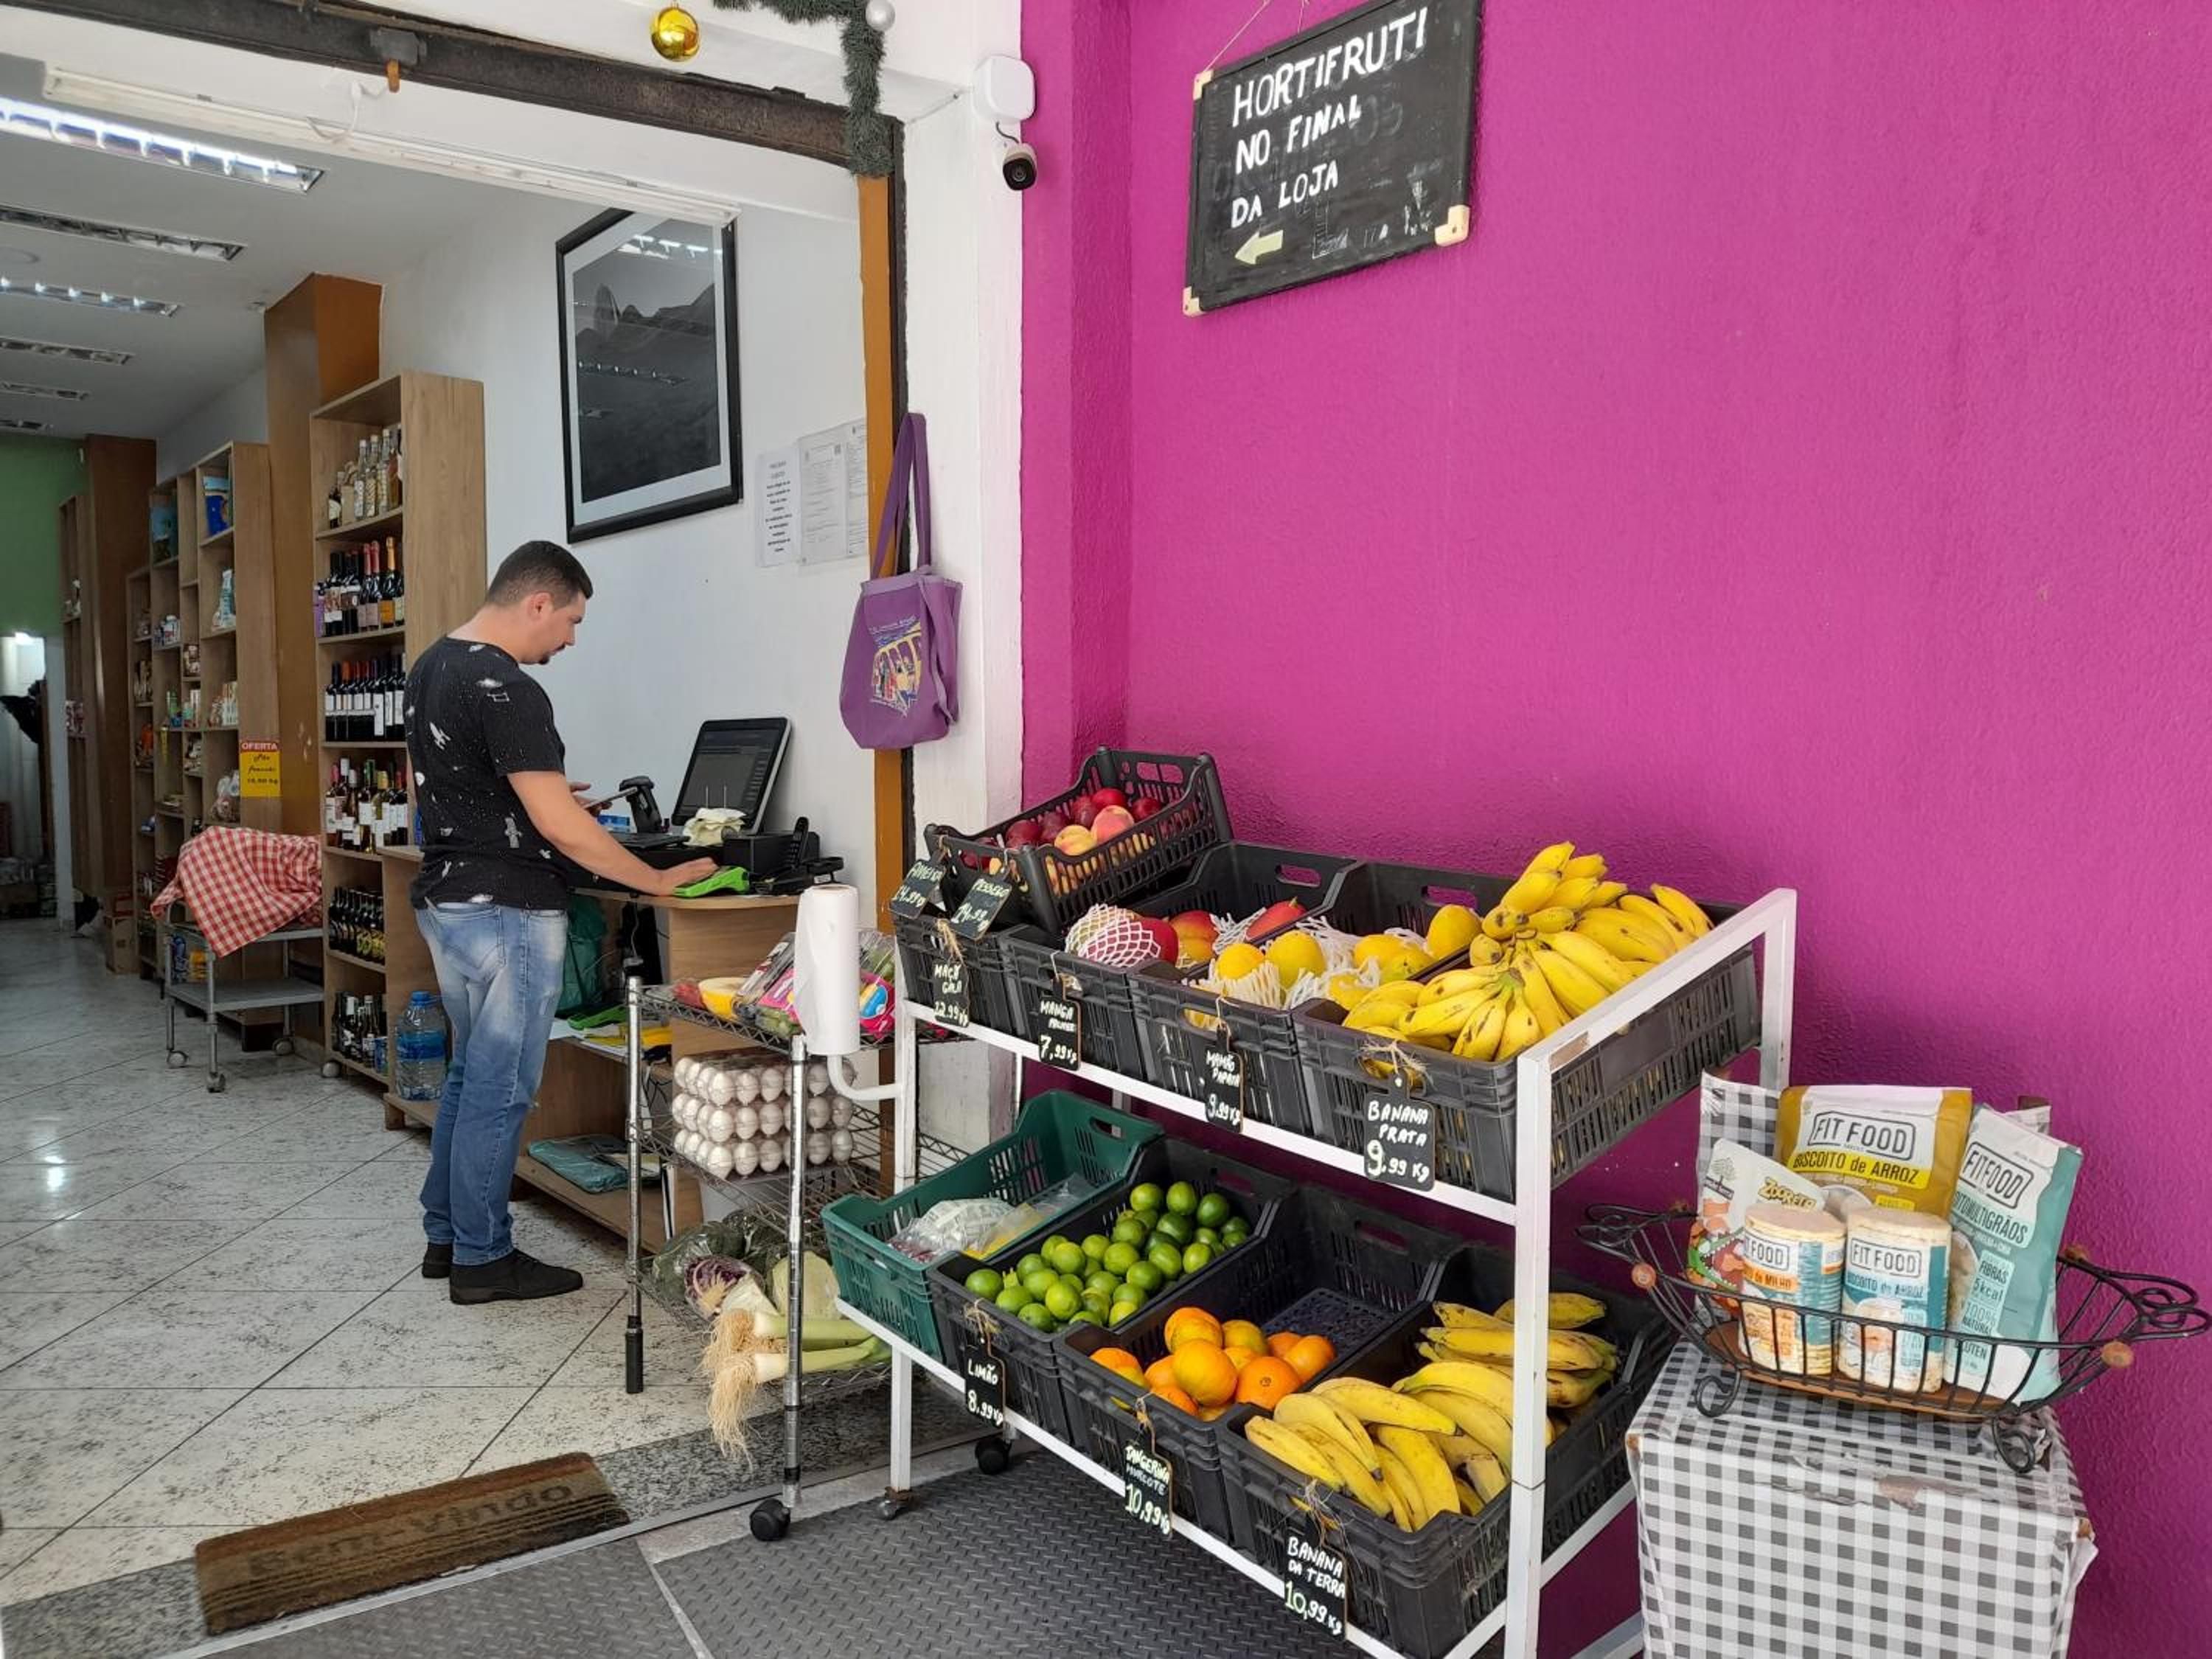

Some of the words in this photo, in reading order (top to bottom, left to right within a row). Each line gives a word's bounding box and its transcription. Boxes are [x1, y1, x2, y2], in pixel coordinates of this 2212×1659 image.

[1232, 7, 1428, 128] HORTIFRUTI
[1235, 129, 1270, 175] NO
[1287, 94, 1362, 154] FINAL
[1231, 196, 1263, 229] DA
[1278, 159, 1339, 209] LOJA
[241, 742, 279, 751] OFERTA
[1040, 1001, 1074, 1020] MANGA
[1368, 1099, 1428, 1124] BANANA
[1379, 1123, 1427, 1147] PRATA
[1813, 1118, 1845, 1142] FIT
[1846, 1121, 1907, 1154] FOOD
[1792, 1150, 1847, 1169] BISCOITO
[1850, 1157, 1866, 1173] de
[1871, 1161, 1920, 1184] ARROZ
[1981, 1160, 2025, 1199] FOOD
[1751, 1240, 1784, 1265] FOOD
[1852, 1243, 1871, 1265] FIT
[1874, 1250, 1916, 1273] FOOD
[1979, 1259, 2009, 1284] FIBRAS
[968, 1358, 998, 1385] LIMÃO
[1125, 1445, 1170, 1484] TANGERINA
[1126, 1462, 1166, 1496] MURCOTE
[1287, 1536, 1343, 1578] BANANA
[1288, 1559, 1302, 1576] DA
[1307, 1568, 1346, 1599] TERRA
